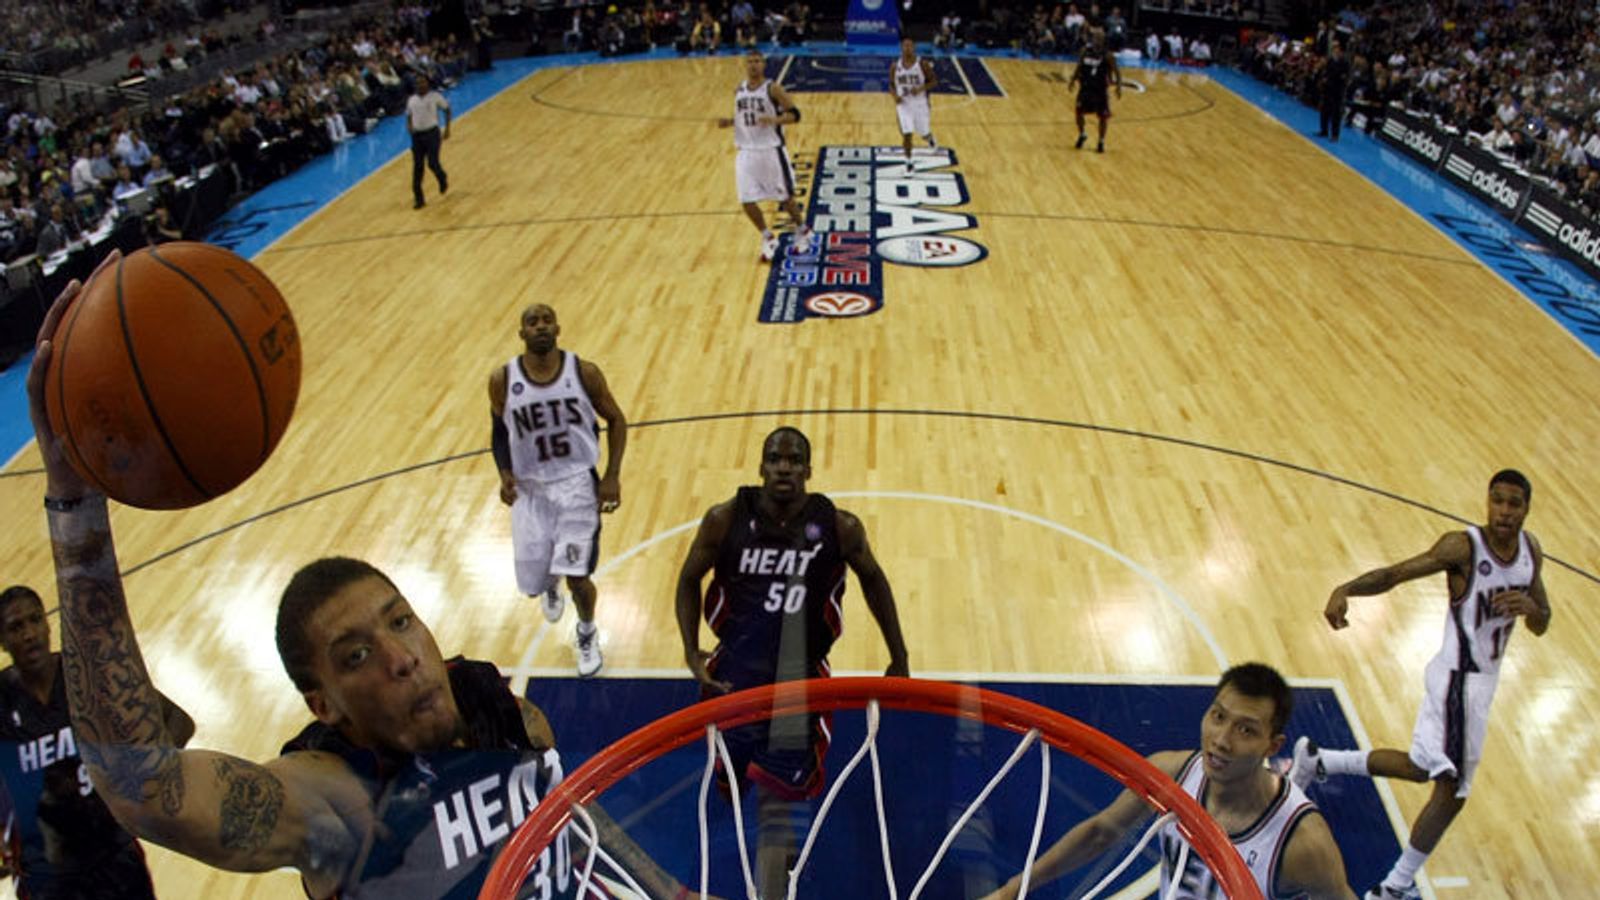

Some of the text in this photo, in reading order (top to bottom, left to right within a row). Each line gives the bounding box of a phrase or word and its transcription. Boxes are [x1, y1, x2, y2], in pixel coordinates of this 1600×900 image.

[737, 98, 765, 113] NETS
[1405, 129, 1442, 162] adidas
[875, 147, 969, 239] NBA
[1472, 169, 1519, 210] adidas
[813, 147, 871, 285] EUROPE LIVE
[512, 398, 583, 440] NETS
[535, 431, 571, 463] 15
[739, 543, 823, 577] HEAT
[764, 582, 807, 614] 50
[18, 726, 77, 773] HEA
